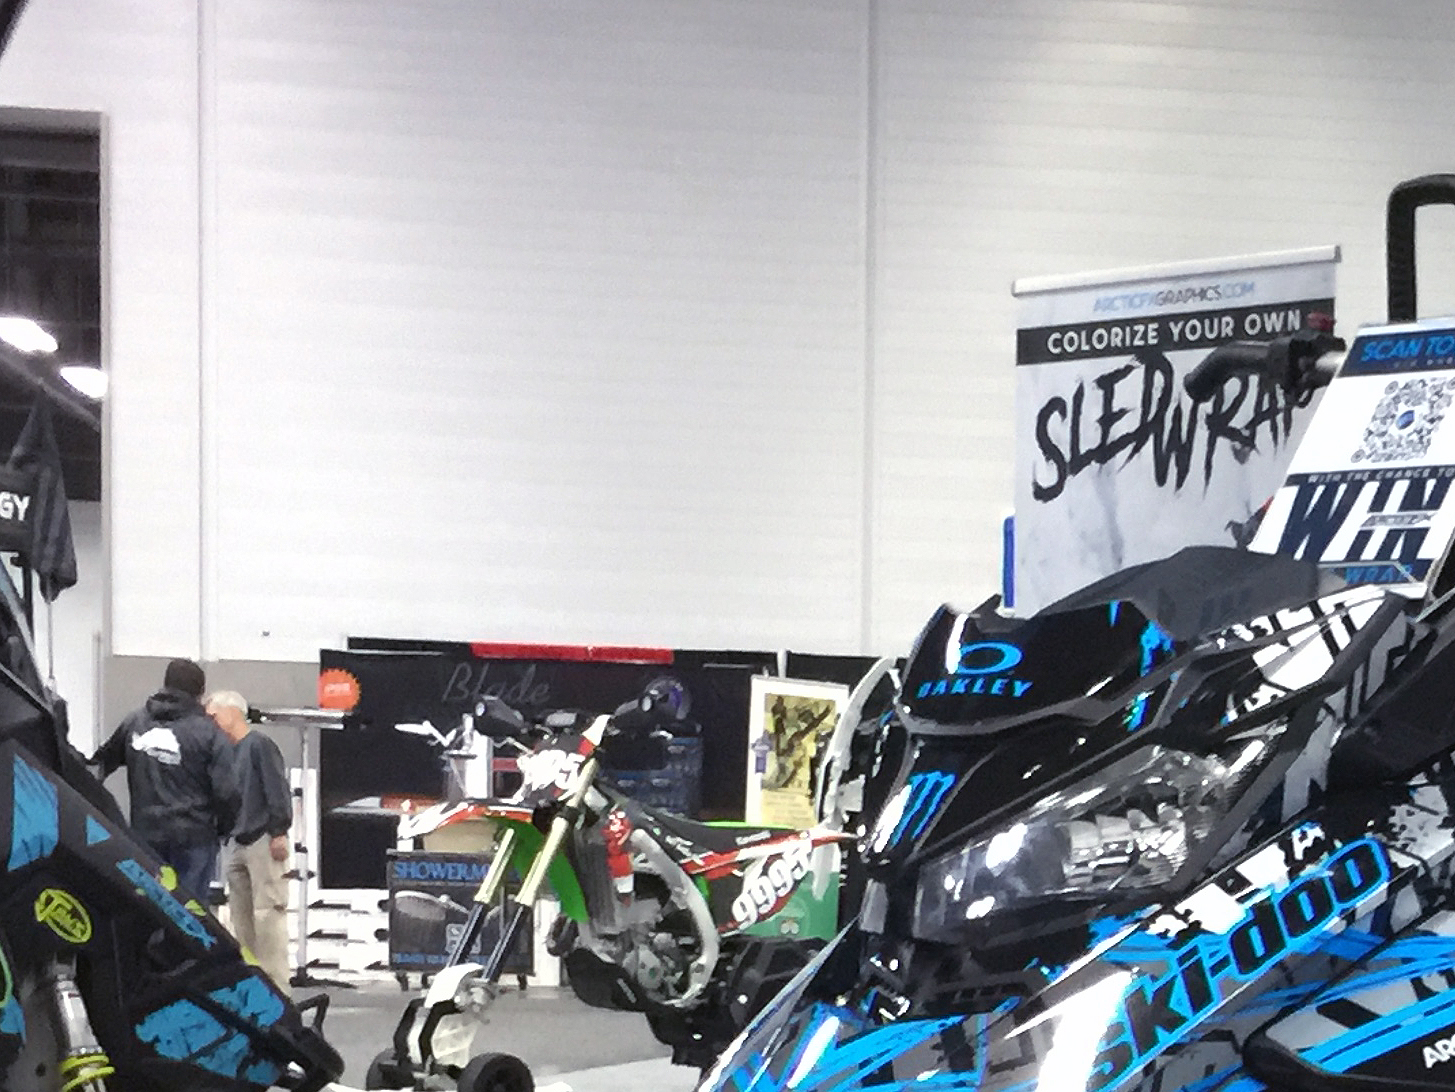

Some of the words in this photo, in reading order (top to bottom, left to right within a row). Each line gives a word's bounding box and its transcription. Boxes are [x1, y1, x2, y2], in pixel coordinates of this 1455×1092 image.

[1047, 323, 1160, 355] COLORIZE
[1168, 316, 1235, 343] YOUR
[1244, 309, 1301, 336] OWN
[1360, 337, 1424, 363] SCAN
[1425, 334, 1455, 356] TO
[1346, 470, 1371, 482] THE
[1375, 467, 1431, 480] CHANCE
[917, 677, 1032, 699] OAKLEY
